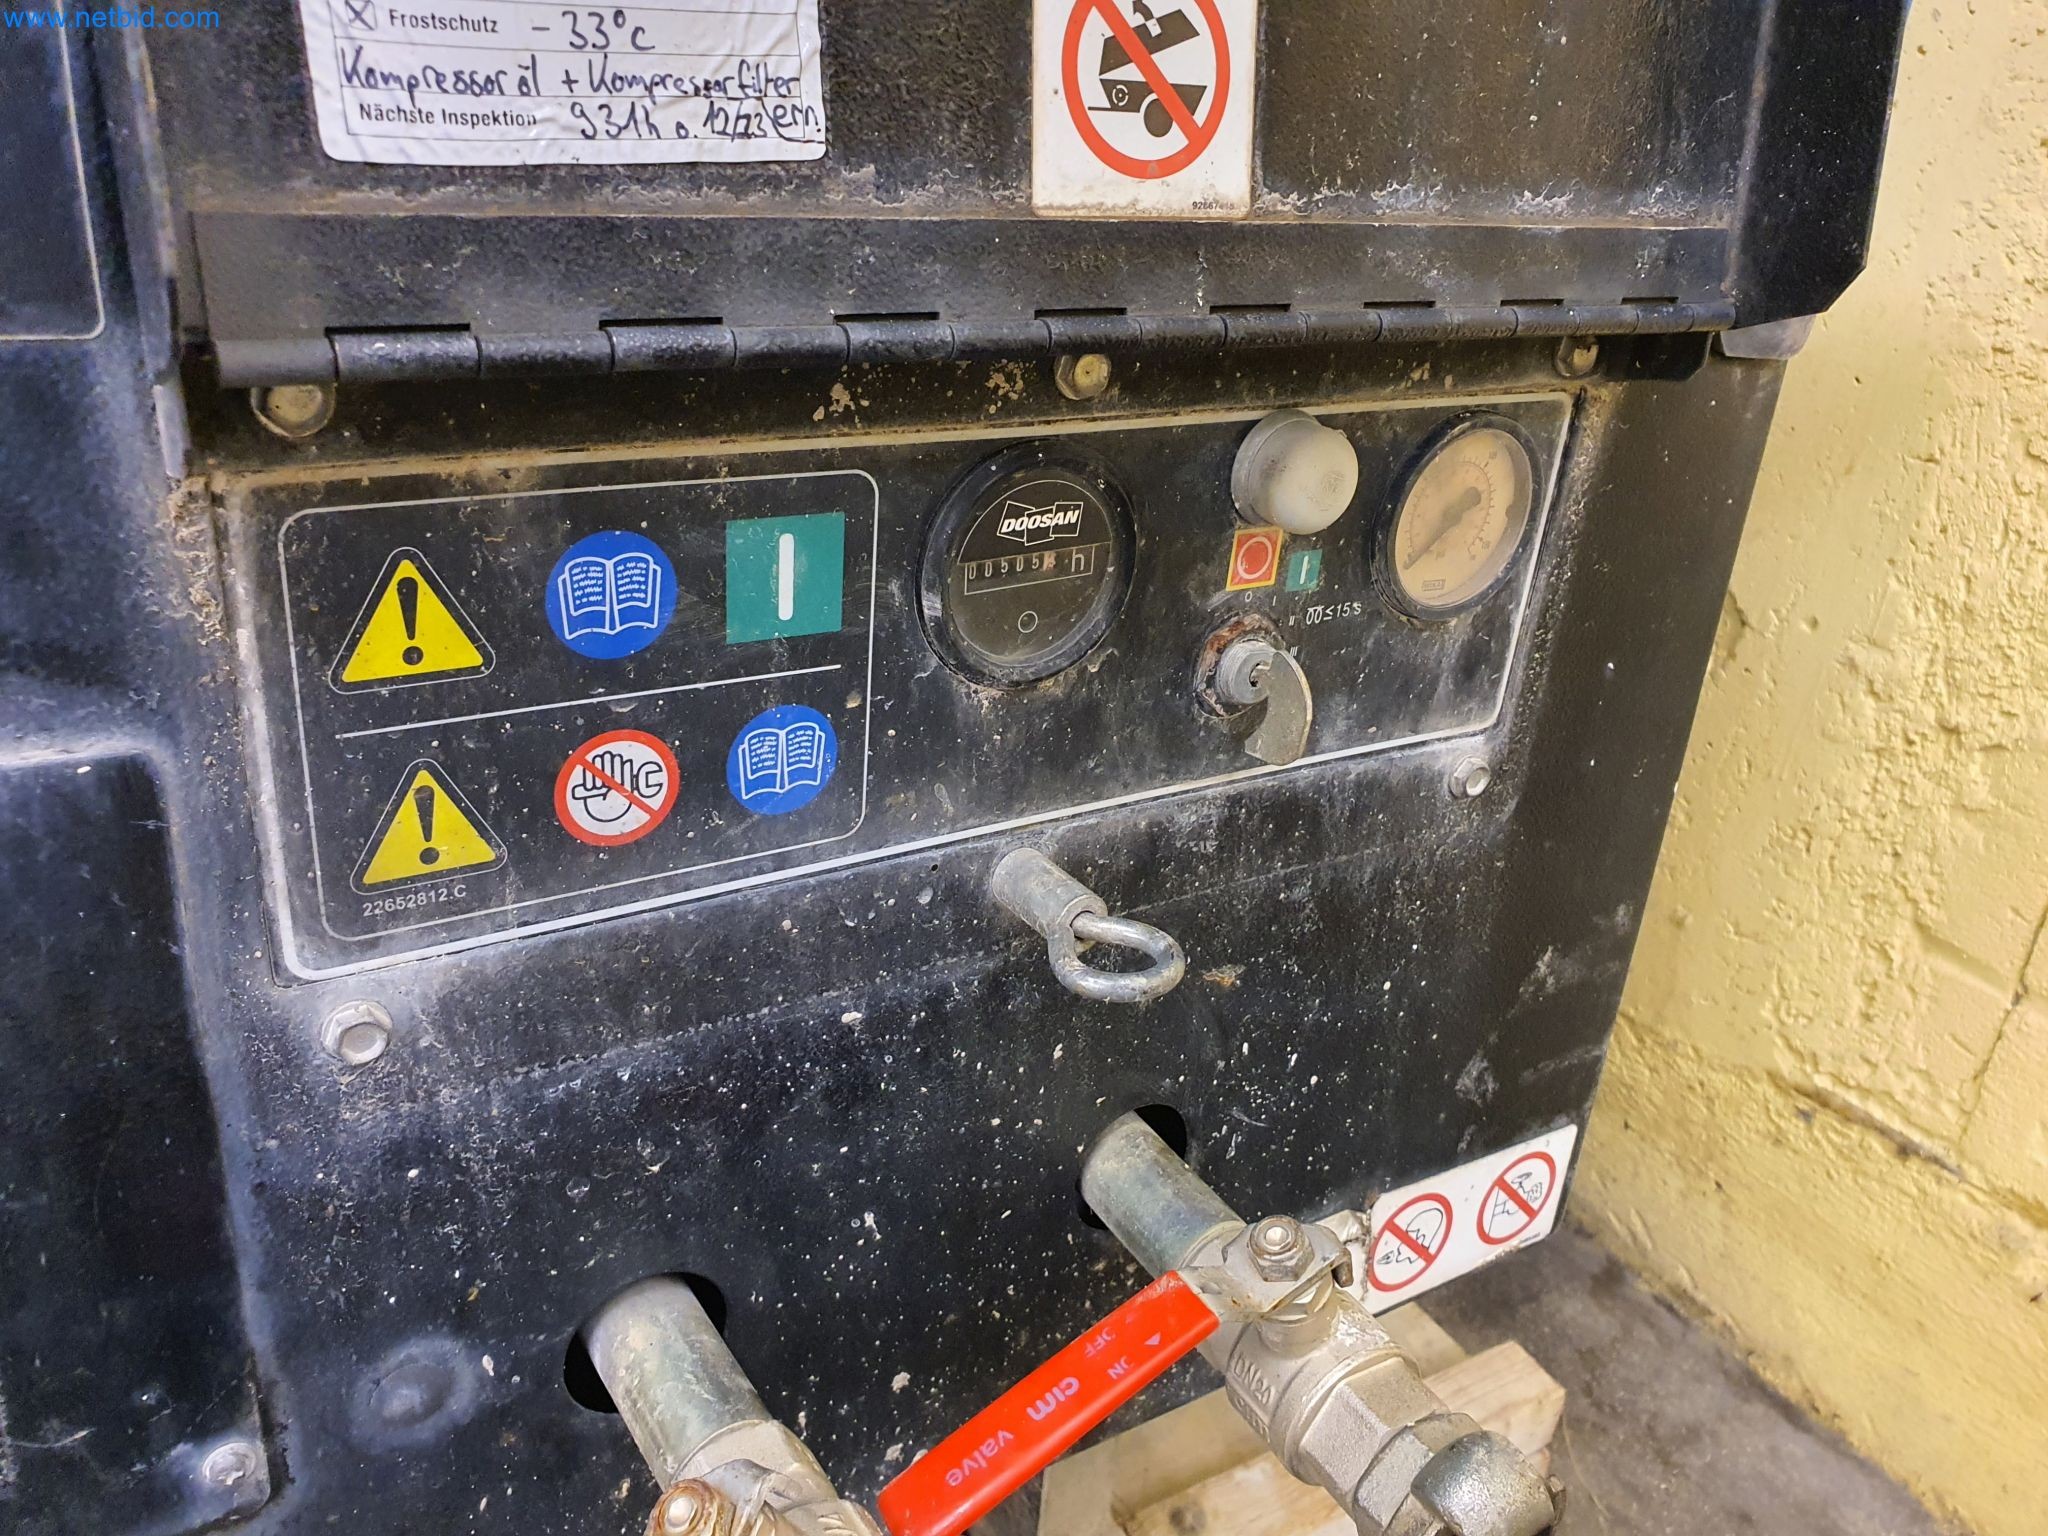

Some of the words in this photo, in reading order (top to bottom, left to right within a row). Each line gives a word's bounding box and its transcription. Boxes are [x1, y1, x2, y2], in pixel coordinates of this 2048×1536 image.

[389, 9, 499, 34] Frostschutz
[561, 69, 579, 94] +
[359, 103, 435, 125] Nächste
[442, 108, 537, 129] Inspektion
[1000, 509, 1080, 534] DOOSAN
[1071, 547, 1085, 573] h
[362, 884, 467, 917] 22652812.C
[1025, 1376, 1081, 1422] cim
[944, 1429, 1015, 1487] valve
